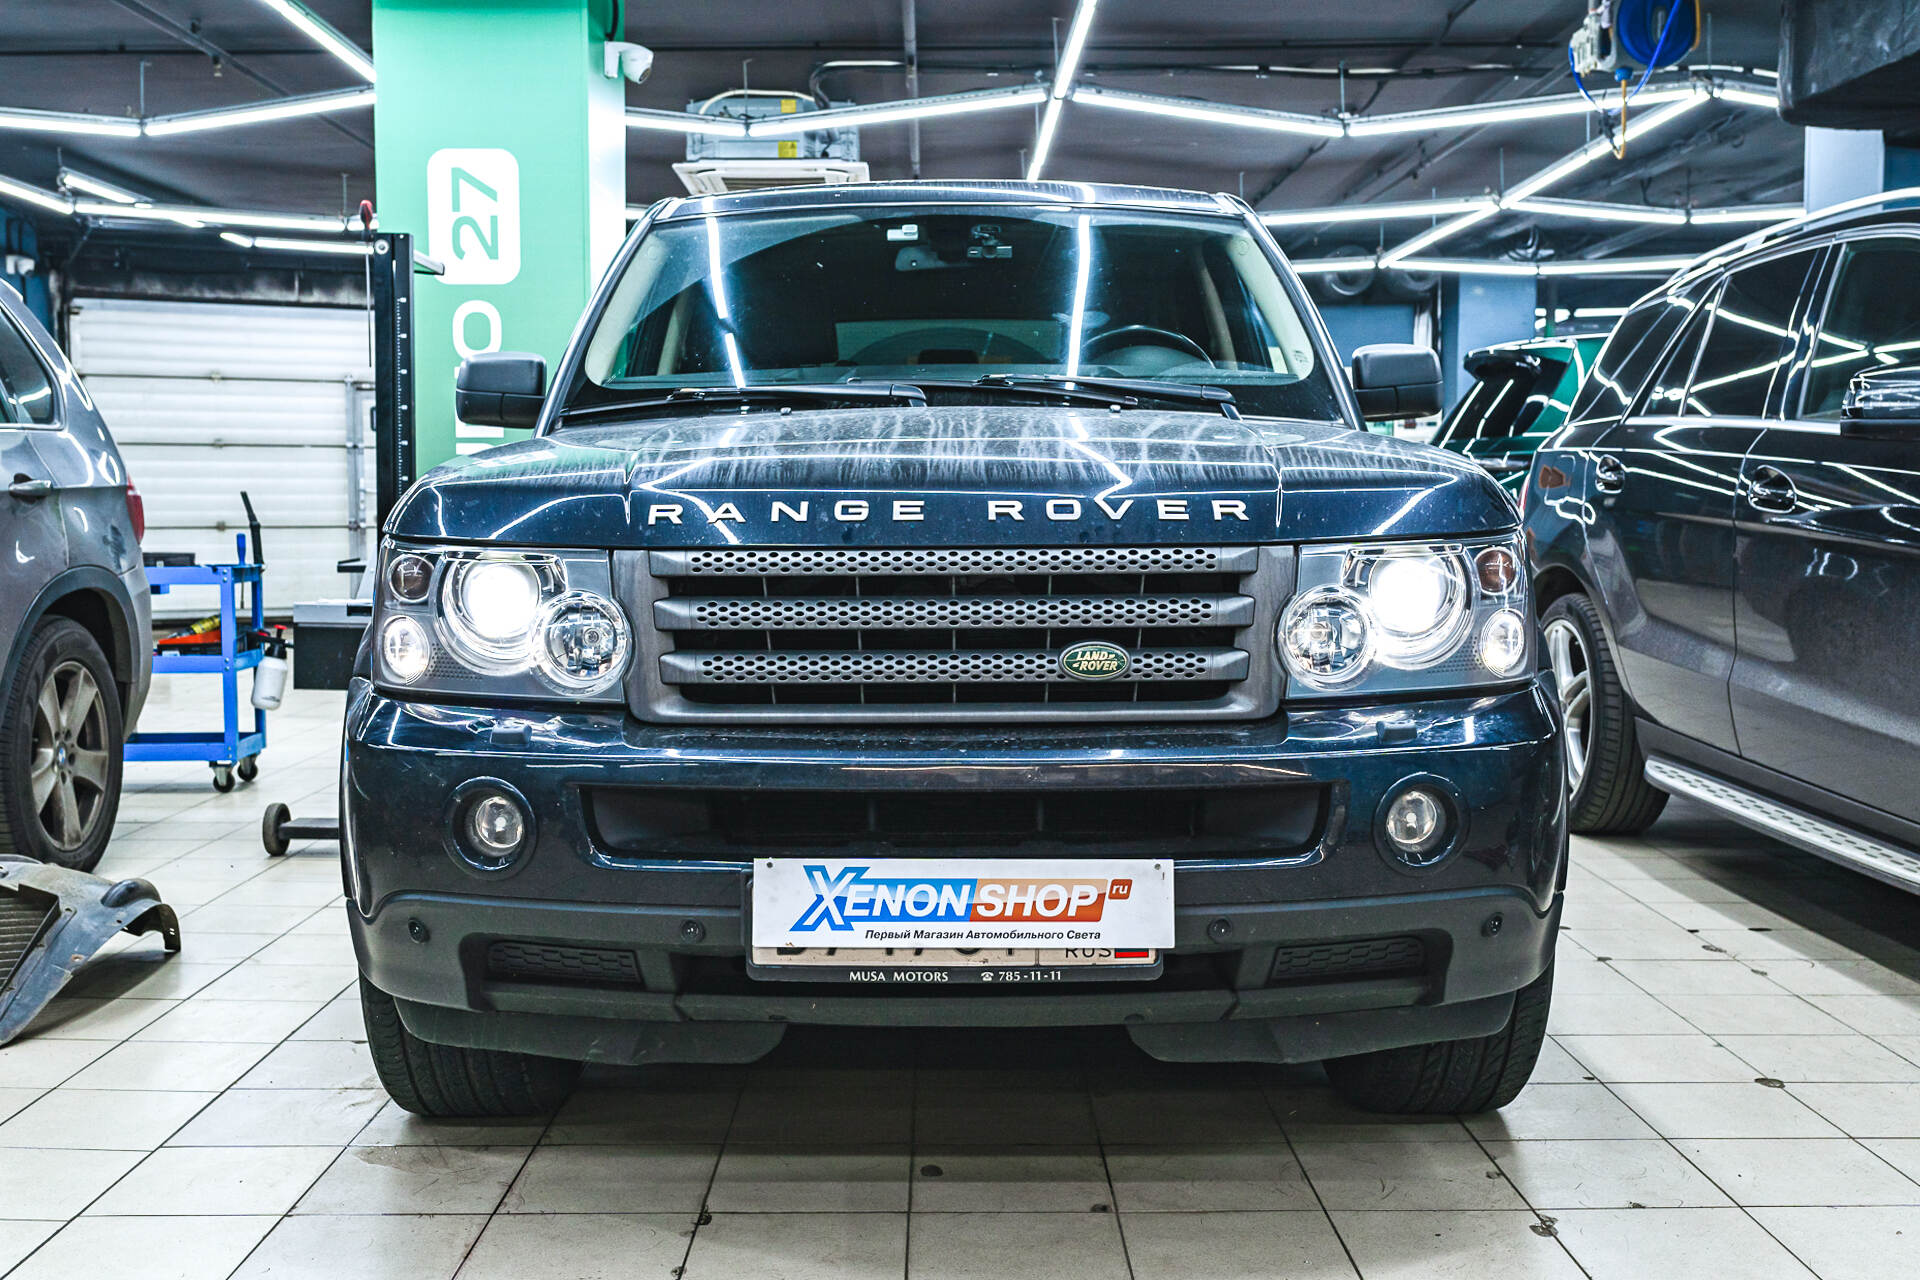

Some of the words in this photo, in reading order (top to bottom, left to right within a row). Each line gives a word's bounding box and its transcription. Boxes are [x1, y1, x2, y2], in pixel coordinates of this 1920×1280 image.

[451, 167, 499, 260] 27
[647, 500, 925, 526] RANGE
[987, 499, 1250, 521] ROVER
[1076, 651, 1108, 661] LAND
[1079, 661, 1118, 671] ROVER
[865, 930, 911, 941] Первый
[913, 930, 963, 940] Магазин
[966, 930, 1064, 940] Автомобильного
[1067, 930, 1101, 940] Света
[849, 971, 886, 982] MUSA
[893, 971, 949, 982] MOTORS
